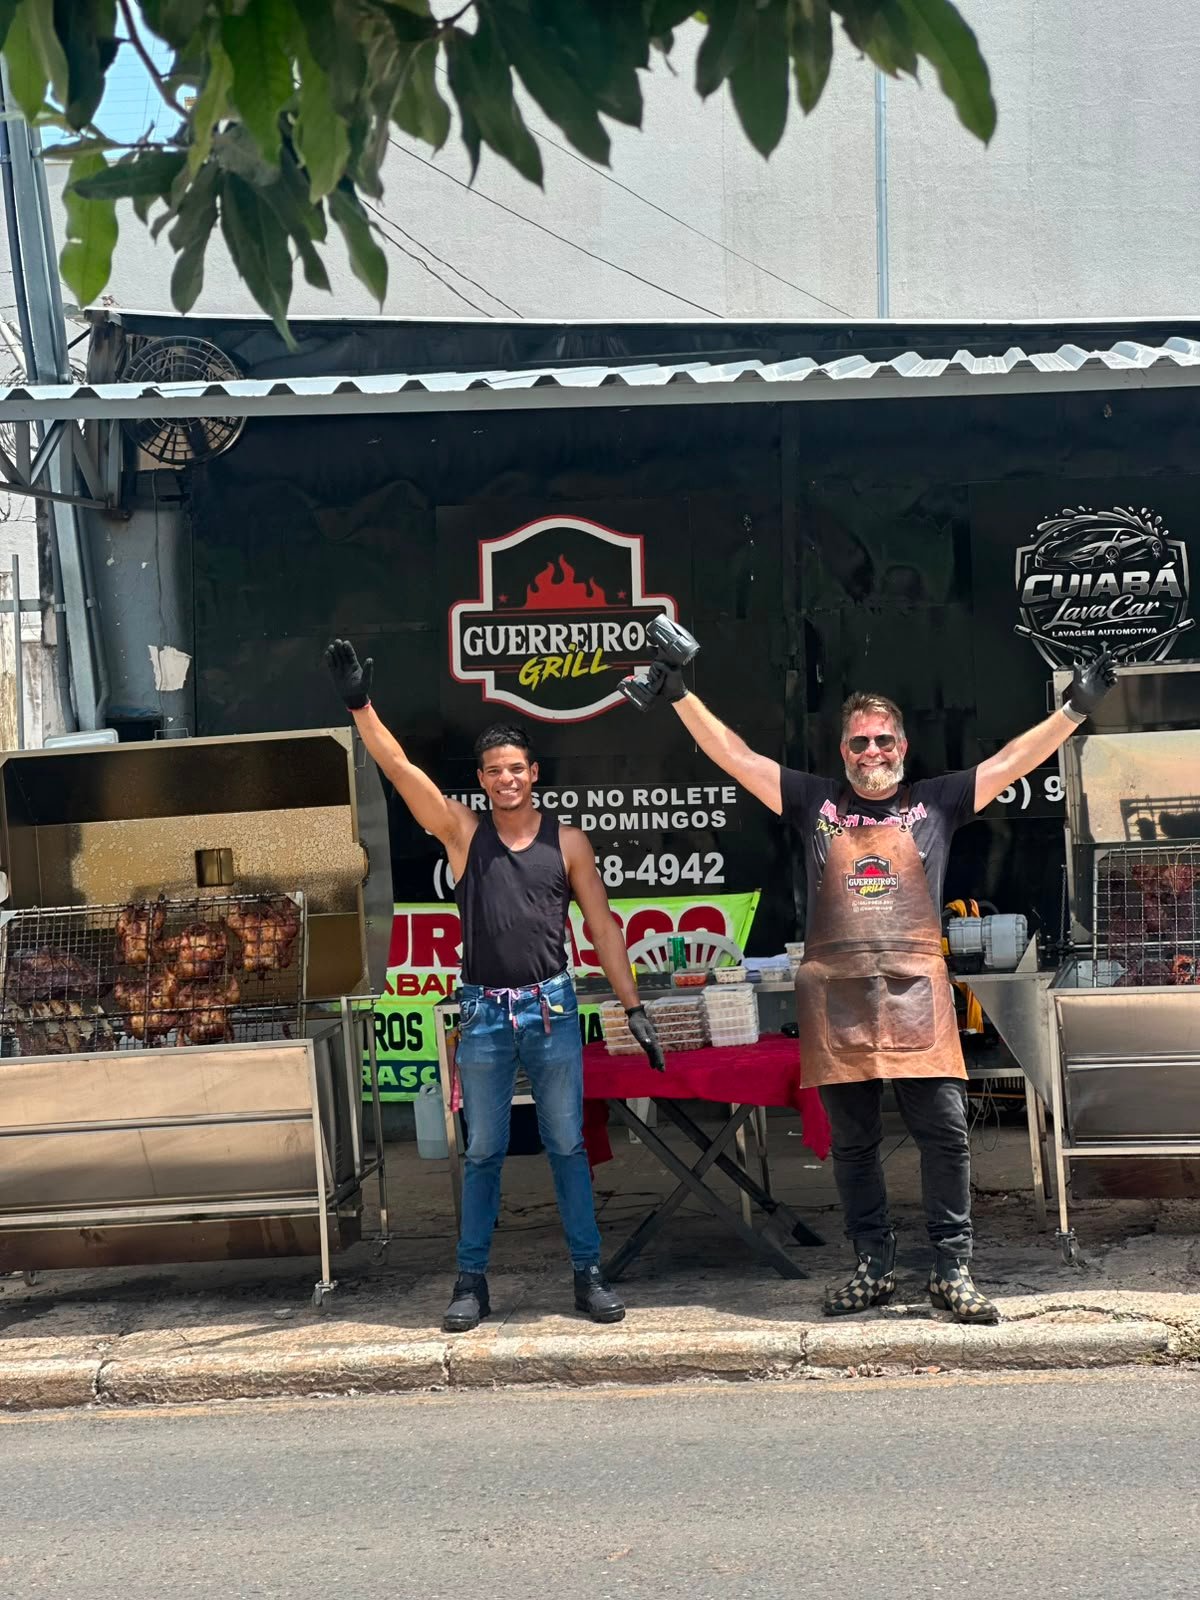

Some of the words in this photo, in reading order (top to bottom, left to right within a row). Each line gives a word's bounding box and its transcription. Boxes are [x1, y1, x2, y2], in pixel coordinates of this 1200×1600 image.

[1021, 561, 1182, 604] CUIABÁ
[1052, 629, 1095, 638] LAVAGEM
[1097, 627, 1158, 637] AUTOMOTIVA
[587, 789, 624, 808] NO
[632, 786, 737, 807] ROLETE
[581, 810, 727, 832] DOMINGOS
[848, 877, 897, 887] GUERREIRO'S
